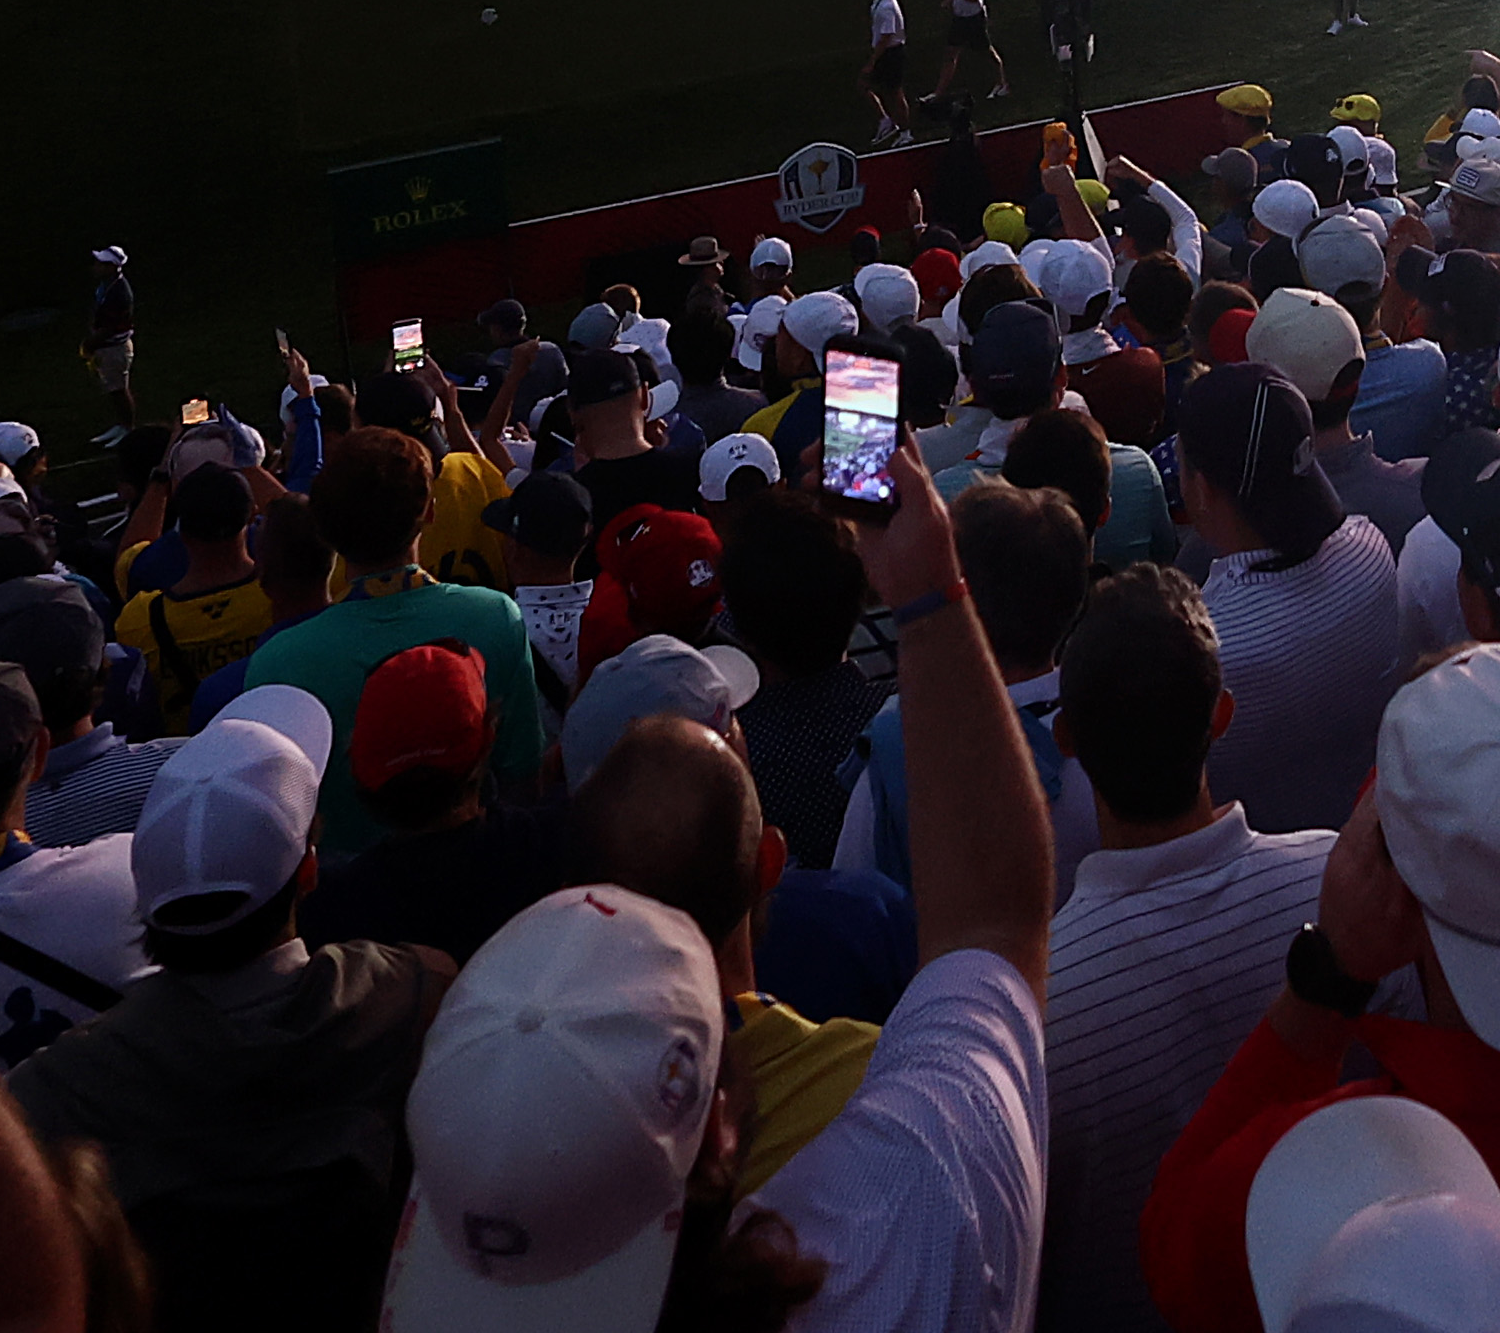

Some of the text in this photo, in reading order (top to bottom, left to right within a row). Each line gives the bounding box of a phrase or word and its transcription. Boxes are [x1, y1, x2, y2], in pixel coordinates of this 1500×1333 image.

[371, 199, 468, 234] ROLEX
[783, 190, 860, 215] RYDER CUP
